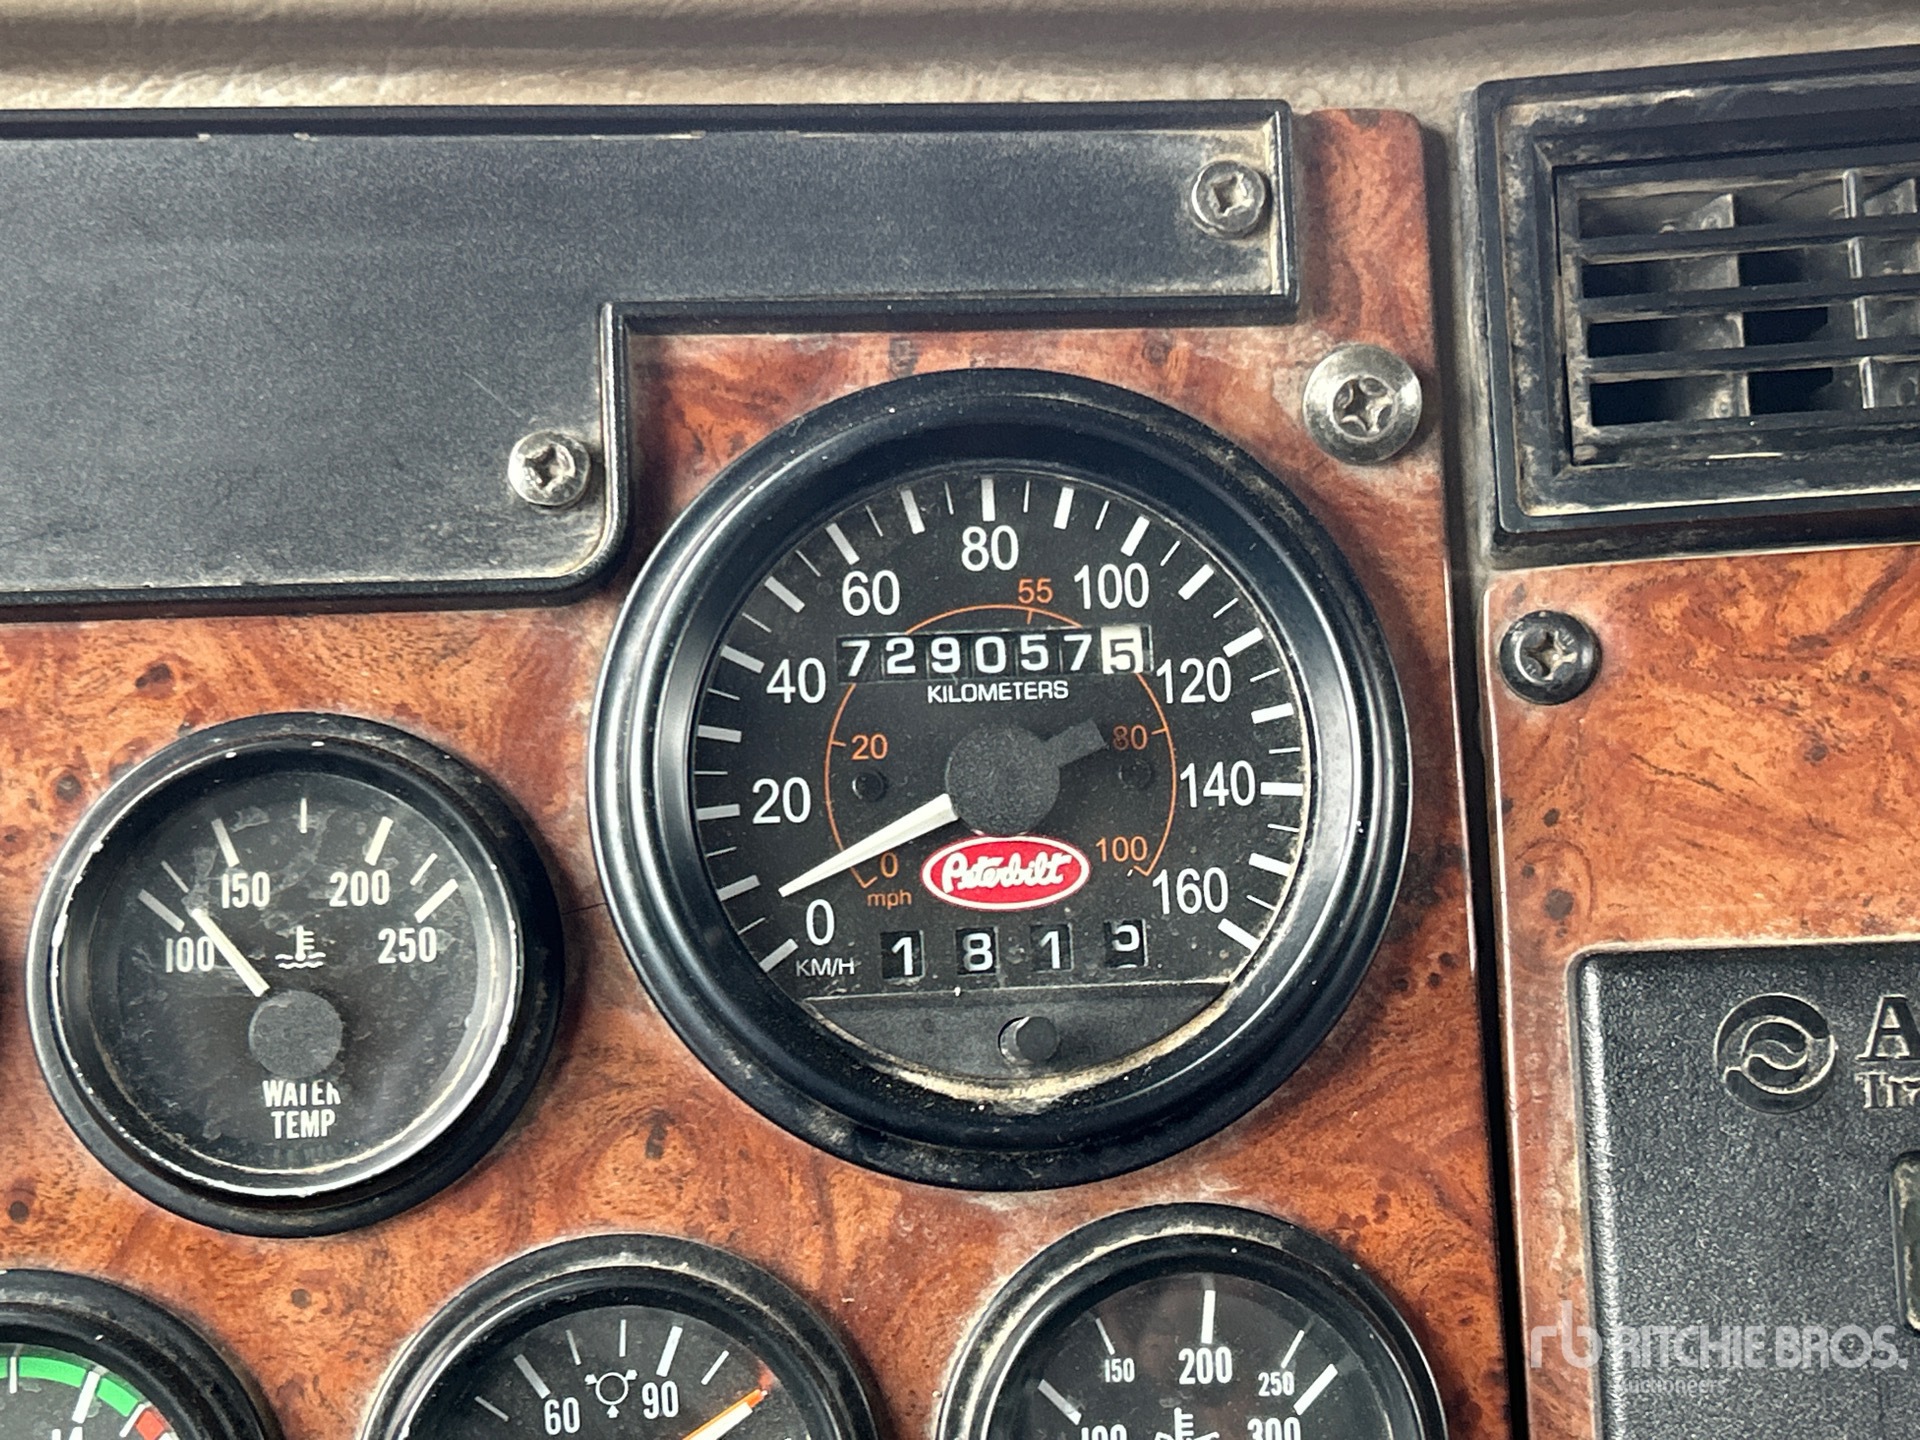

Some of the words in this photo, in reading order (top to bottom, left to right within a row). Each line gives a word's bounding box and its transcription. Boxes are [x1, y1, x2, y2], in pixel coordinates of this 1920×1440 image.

[961, 525, 1019, 571] 80
[841, 570, 900, 616] 60
[1018, 578, 1053, 604] 55
[1074, 563, 1149, 610] 100
[766, 658, 826, 704] 40
[927, 680, 1069, 704] KILOMETERS
[1156, 658, 1232, 704] 120
[852, 734, 888, 760] 20
[1112, 725, 1148, 751] 80
[751, 777, 811, 824] 20
[1180, 762, 1255, 807] 140
[879, 852, 899, 878] 0
[1096, 836, 1148, 864] 100
[220, 871, 271, 909] 150
[328, 870, 390, 907] 200
[942, 852, 1072, 894] Peterbilt
[1153, 867, 1229, 915] 160
[867, 890, 912, 907] mph
[805, 898, 836, 946] 0
[165, 936, 215, 973] 100
[377, 927, 437, 964] 250
[796, 957, 856, 978] KM/H
[270, 1108, 336, 1139] TEMP
[1104, 1358, 1135, 1383] 150
[1178, 1346, 1233, 1385] 200
[1257, 1371, 1295, 1397] 250
[543, 1397, 581, 1436] 60
[641, 1380, 679, 1419] 90
